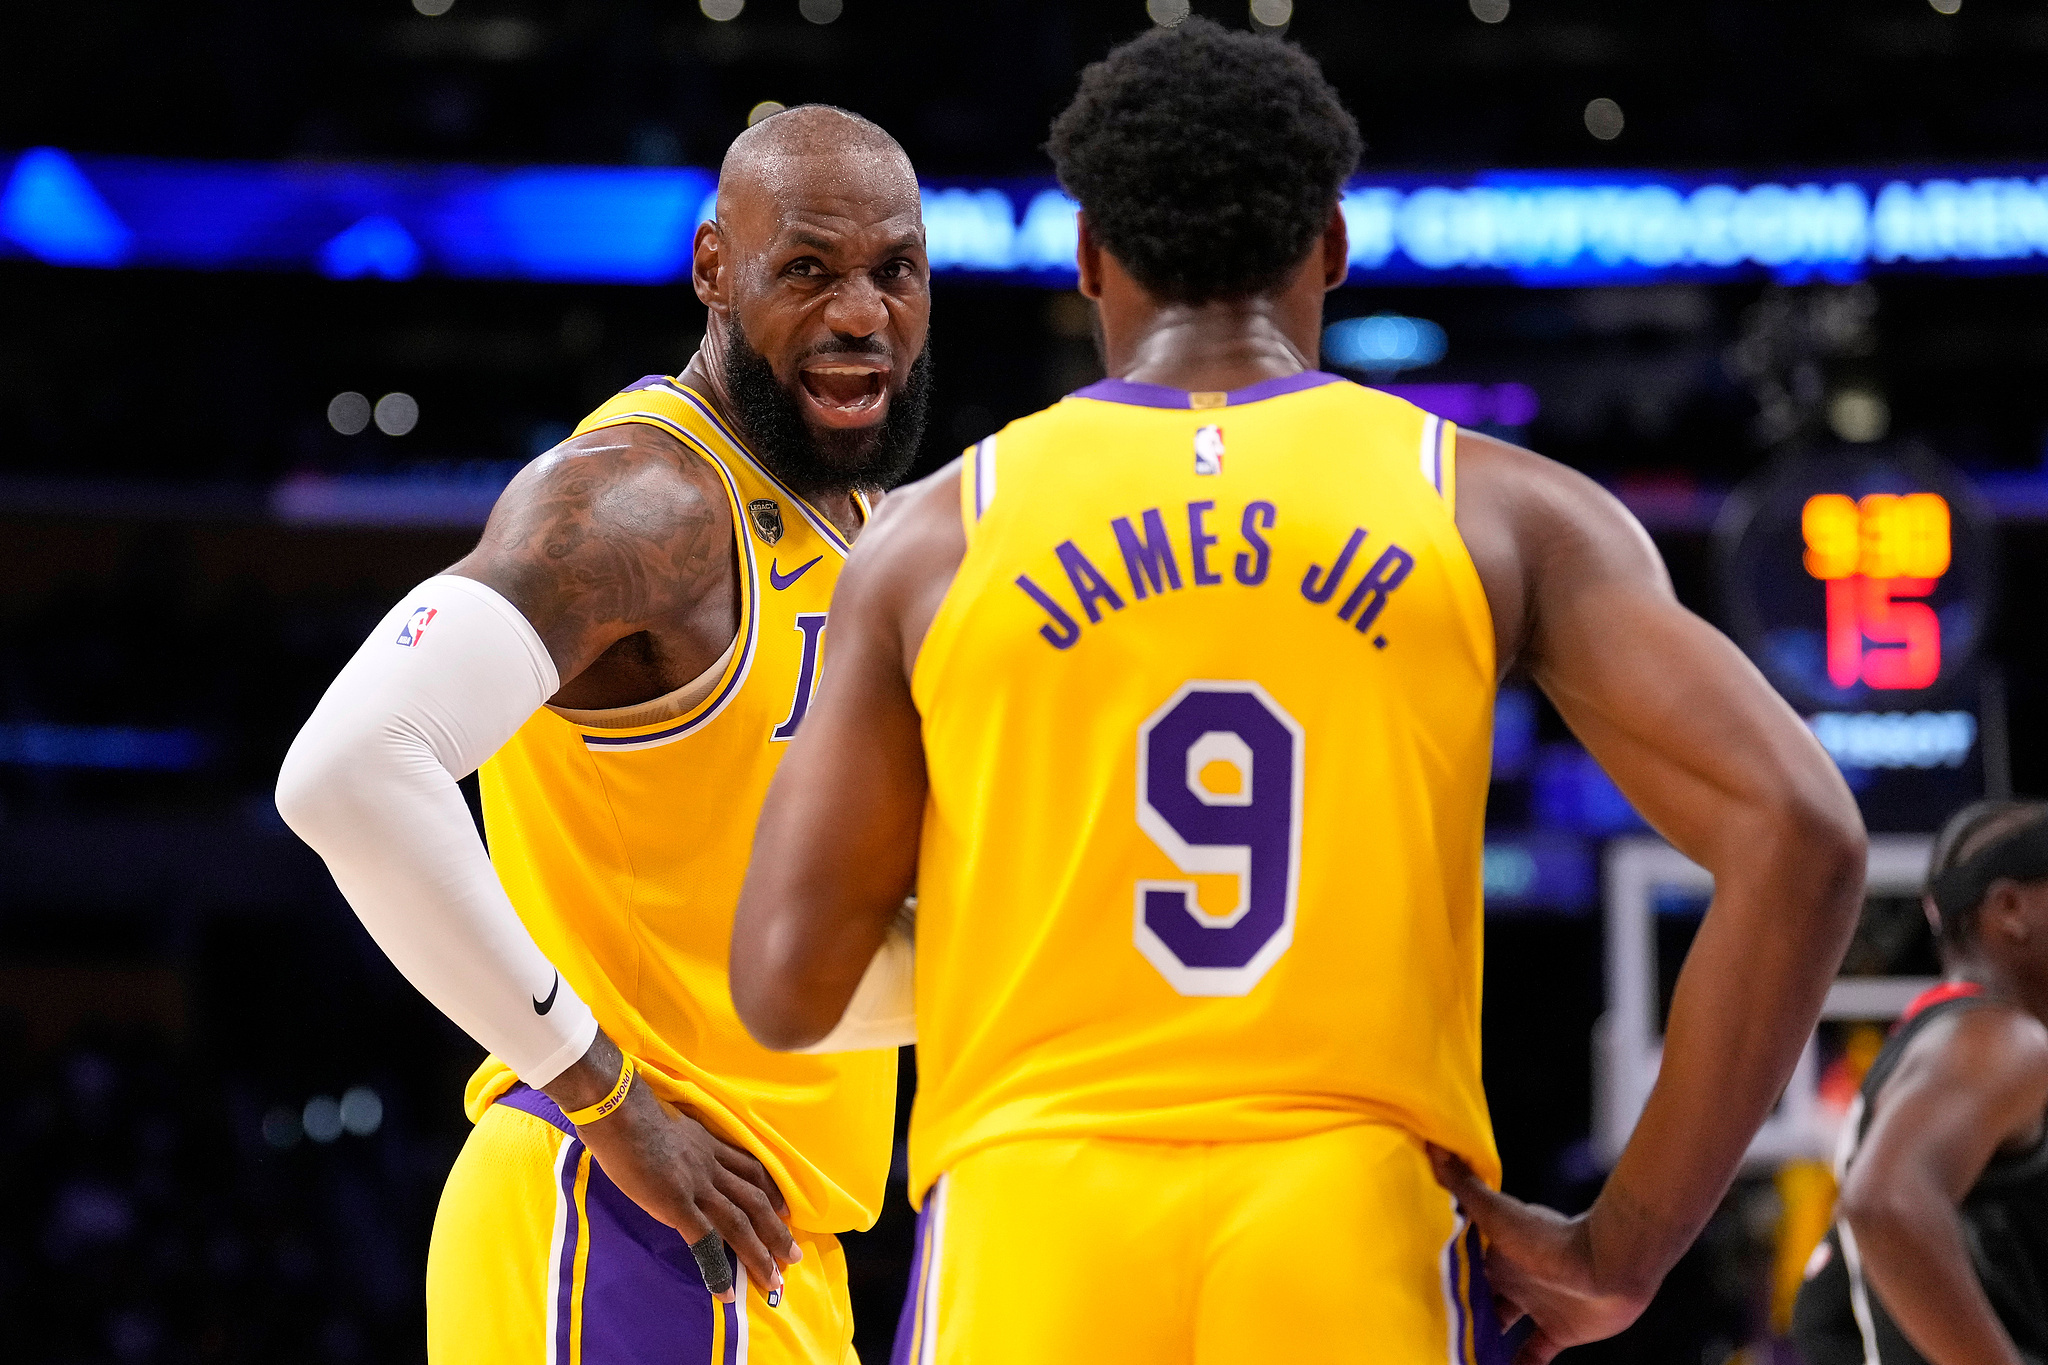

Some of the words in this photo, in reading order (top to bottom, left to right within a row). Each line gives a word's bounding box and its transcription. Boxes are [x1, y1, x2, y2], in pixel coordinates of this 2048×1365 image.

[750, 503, 774, 511] LEGACY
[1014, 500, 1277, 651] JAMES
[1300, 527, 1415, 650] JR.
[1824, 574, 1941, 690] 15
[1133, 678, 1305, 997] 9
[596, 1073, 630, 1115] PROMISE
